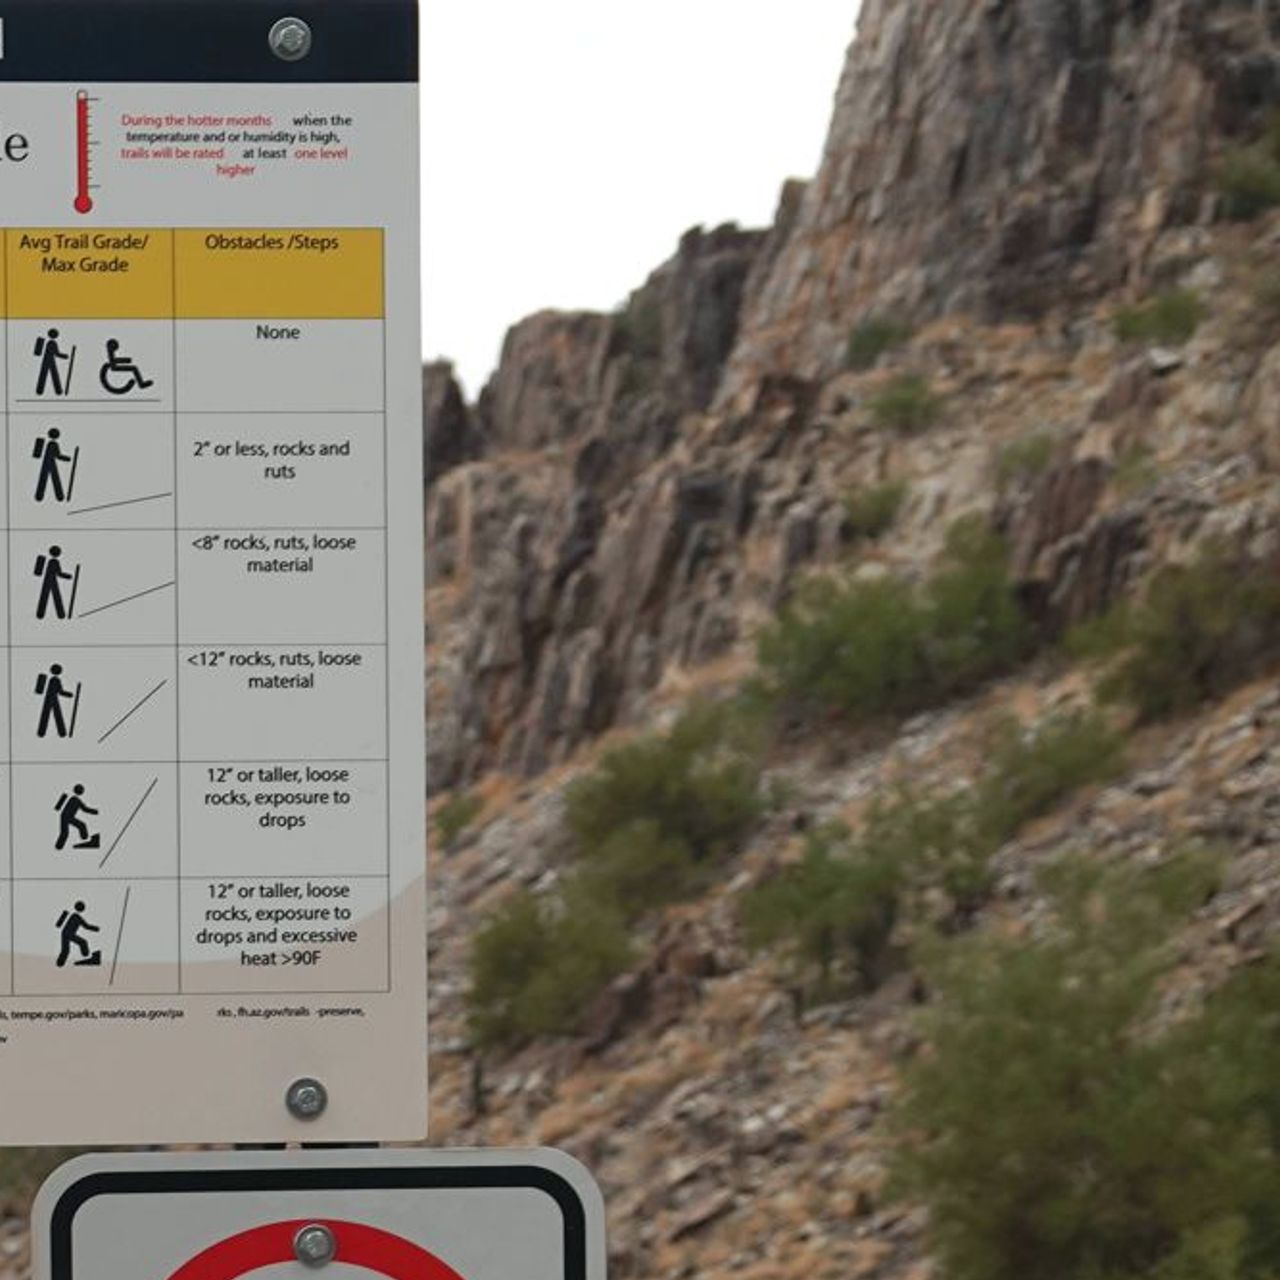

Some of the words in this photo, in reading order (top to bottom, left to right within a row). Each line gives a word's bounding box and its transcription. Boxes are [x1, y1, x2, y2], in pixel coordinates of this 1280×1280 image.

[121, 114, 162, 128] During
[164, 114, 185, 127] the
[186, 114, 224, 127] hotter
[226, 114, 272, 127] months
[292, 115, 328, 127] when
[330, 115, 352, 127] the
[125, 131, 201, 145] temperature
[202, 131, 226, 143] and
[227, 133, 242, 143] or
[242, 131, 296, 145] humidity
[297, 131, 309, 143] is
[309, 131, 340, 145] high,
[120, 147, 151, 159] trails
[151, 147, 173, 159] will
[175, 147, 191, 159] be
[192, 147, 225, 159] rated
[242, 149, 255, 159] at
[257, 148, 287, 159] least
[294, 150, 318, 159] one
[319, 147, 348, 159] level
[216, 163, 256, 178] higher
[19, 234, 52, 254] Avg
[54, 233, 92, 250] Trail
[92, 233, 149, 250] Grade/
[204, 233, 285, 250] Obstacles
[286, 233, 339, 253] /Steps
[41, 257, 79, 273] Max
[79, 256, 129, 273] Grade
[256, 324, 301, 340] None
[213, 444, 232, 457] or
[235, 440, 270, 458] less,
[272, 440, 316, 457] rocks
[318, 440, 351, 456] and
[264, 465, 297, 480] ruts
[240, 950, 277, 967] heat
[281, 950, 321, 966] >90F
